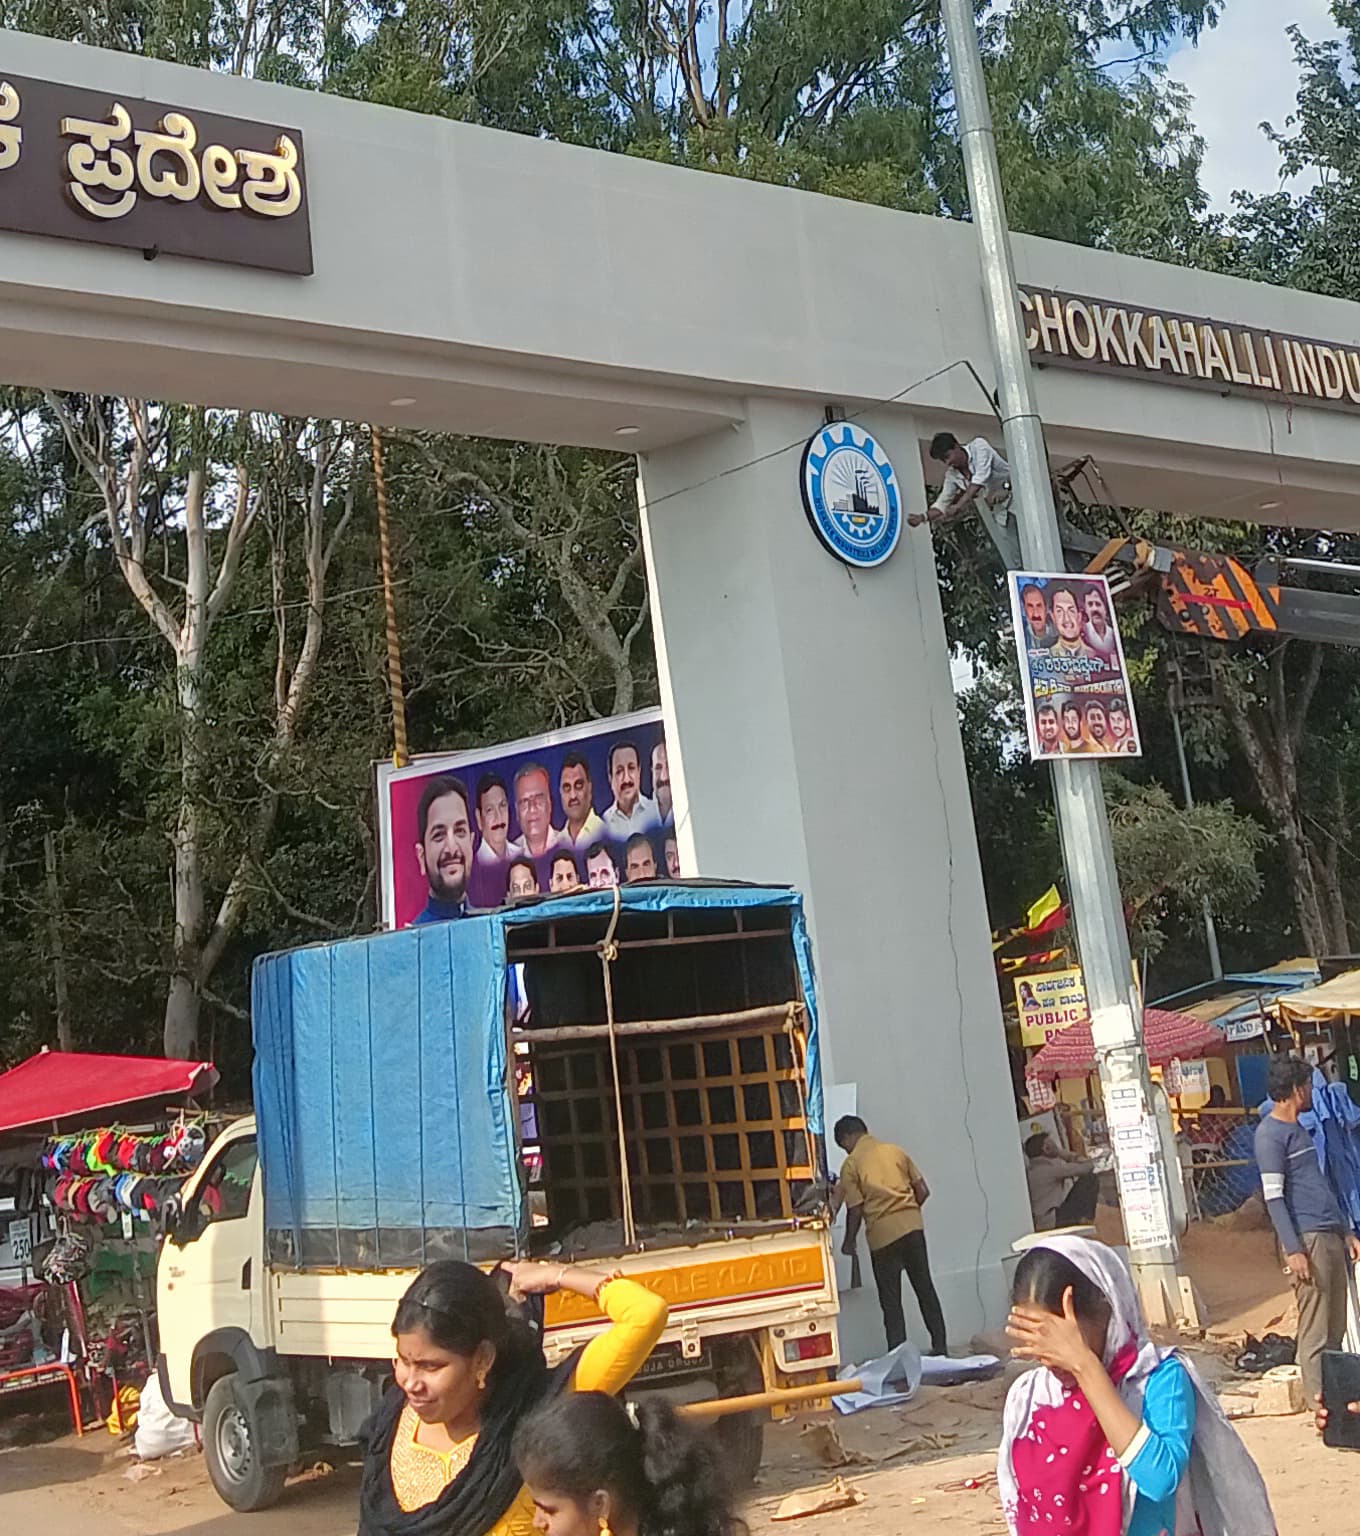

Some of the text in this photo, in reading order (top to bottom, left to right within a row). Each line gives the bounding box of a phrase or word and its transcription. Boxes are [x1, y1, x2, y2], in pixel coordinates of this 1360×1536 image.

[61, 102, 302, 218] ಪ್ರದೇಶ
[1018, 290, 1282, 391] CHOKKAHALLI
[1026, 1009, 1078, 1027] PUBLIC
[13, 1238, 31, 1260] 250
